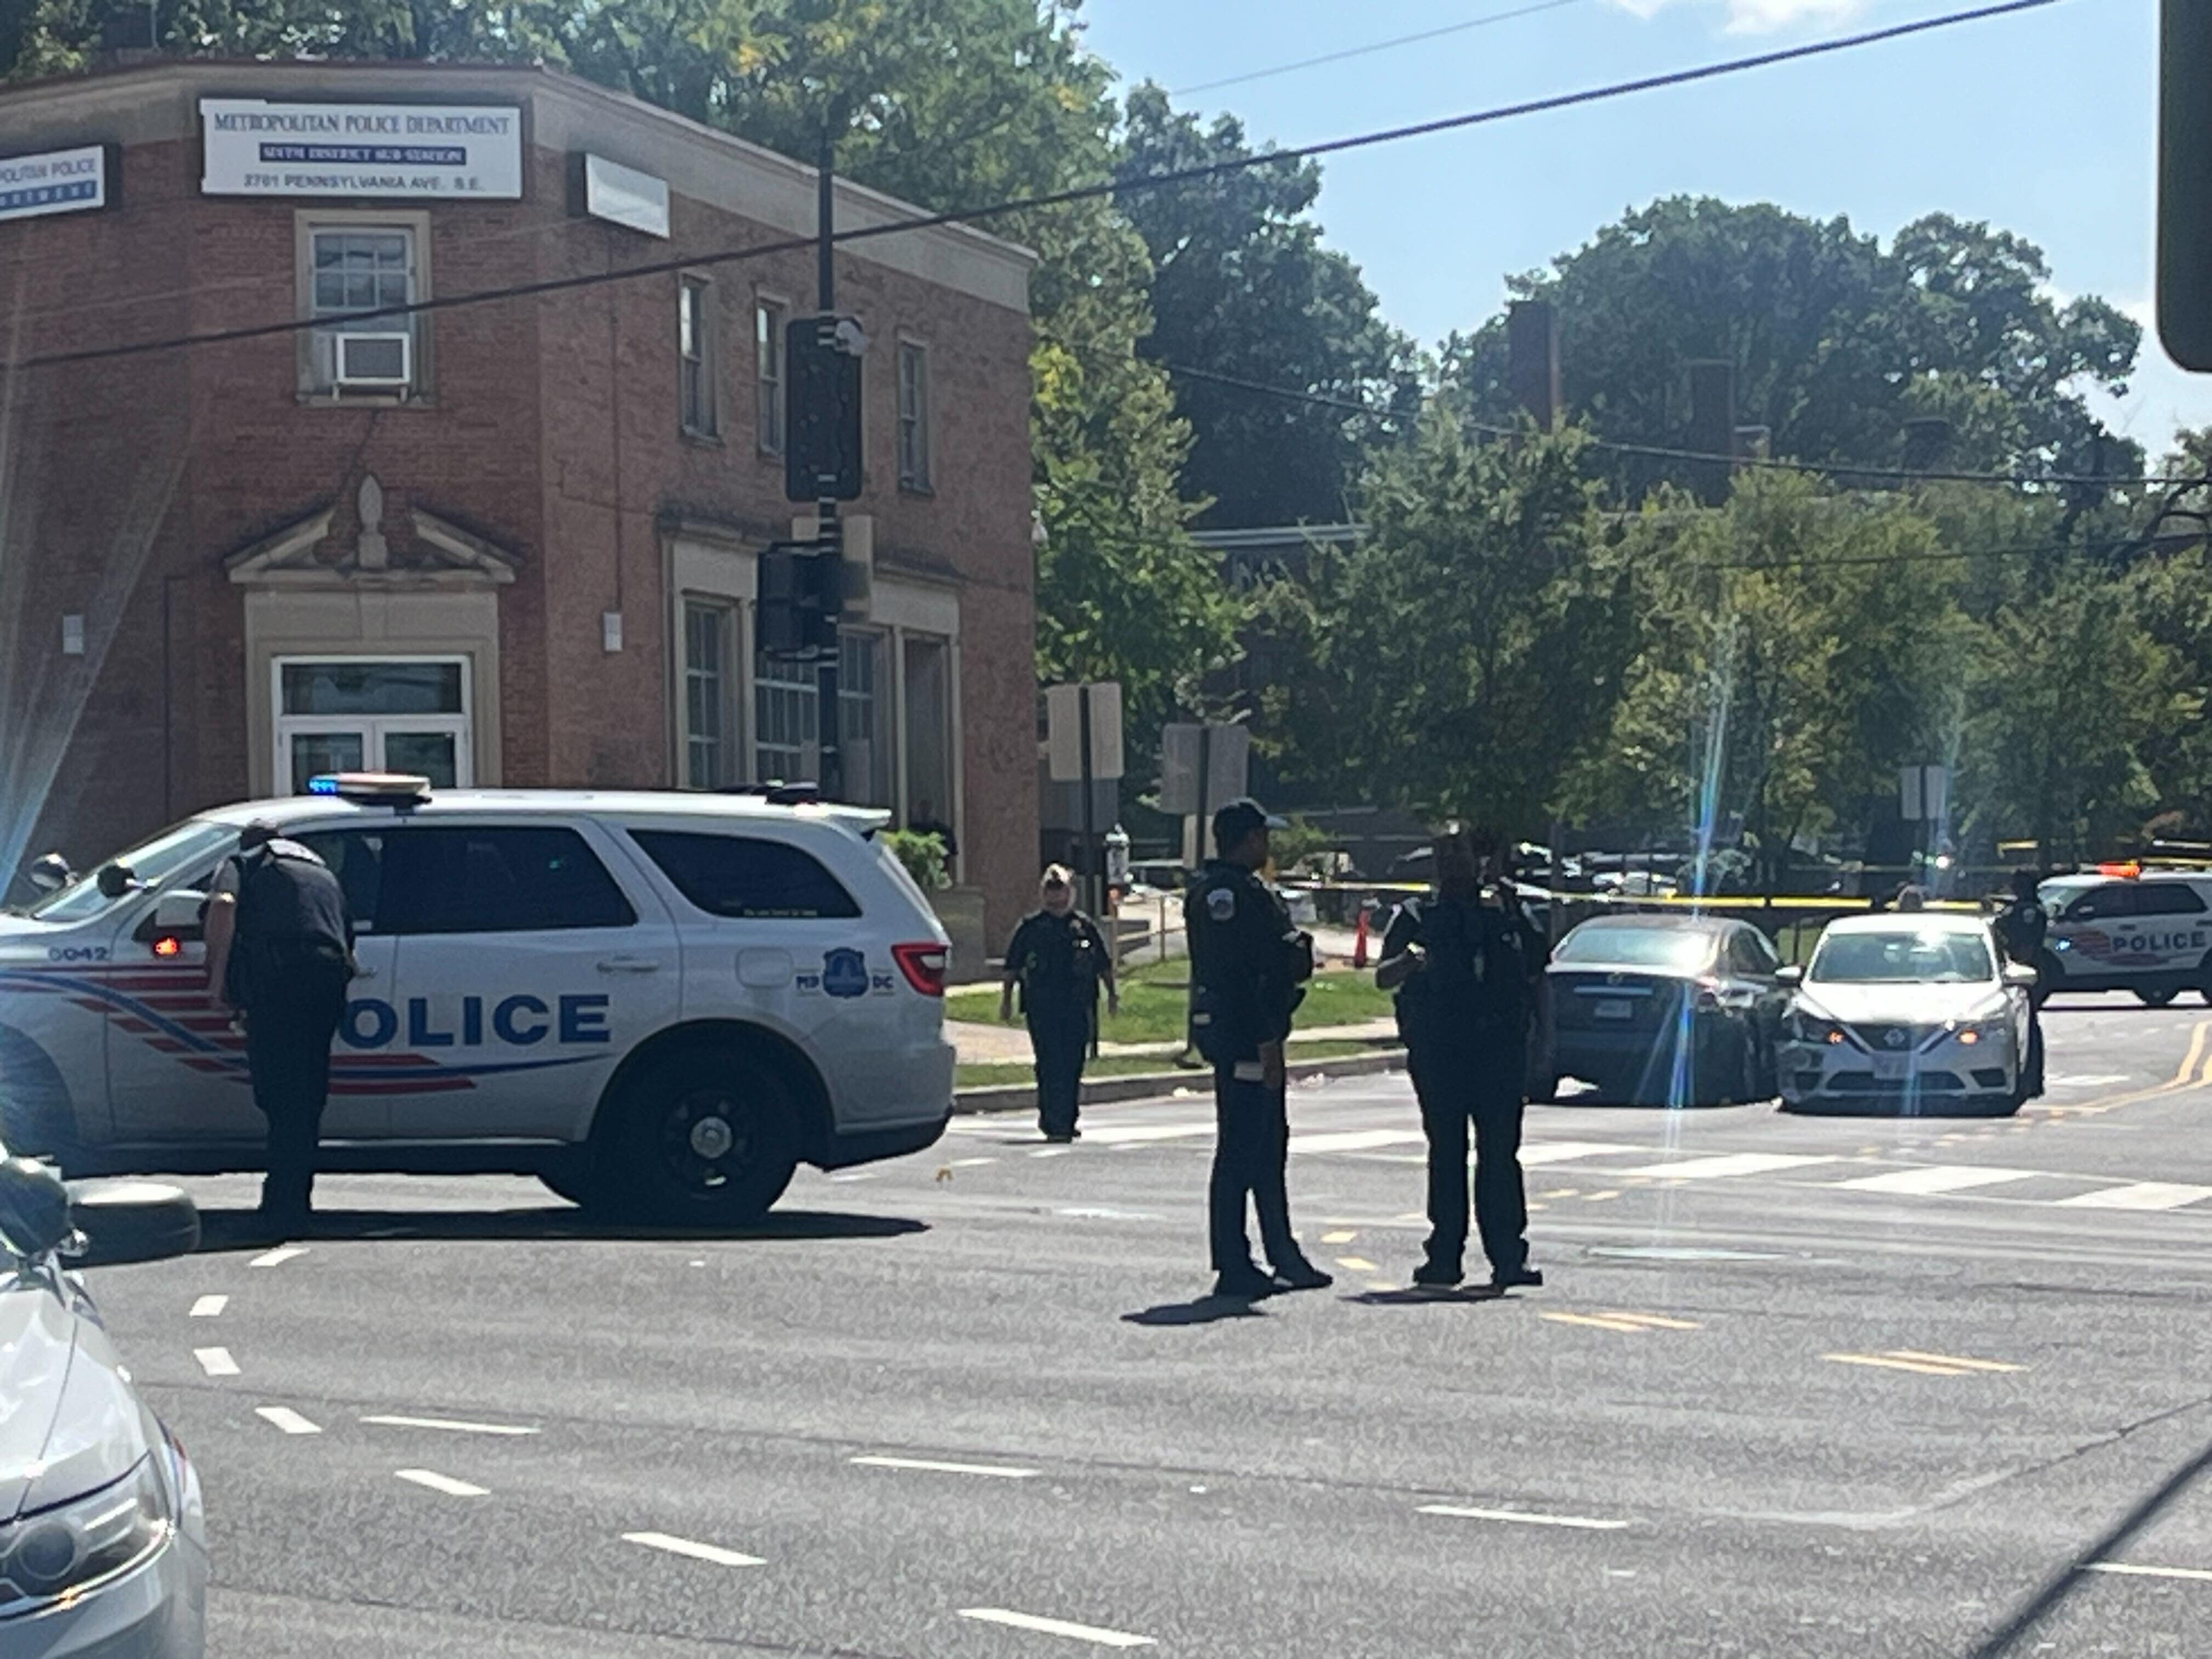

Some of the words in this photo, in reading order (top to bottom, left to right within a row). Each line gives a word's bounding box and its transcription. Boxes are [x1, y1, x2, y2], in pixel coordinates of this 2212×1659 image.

[215, 114, 339, 131] METROPOLITAN
[346, 115, 400, 132] POLICE
[407, 116, 509, 133] DEPARTMENT
[52, 159, 95, 178] POLICE
[245, 174, 279, 187] 2701
[285, 174, 405, 189] PENNSYLVANIA
[2113, 930, 2205, 952] POLICE
[339, 995, 611, 1049] OLICE
